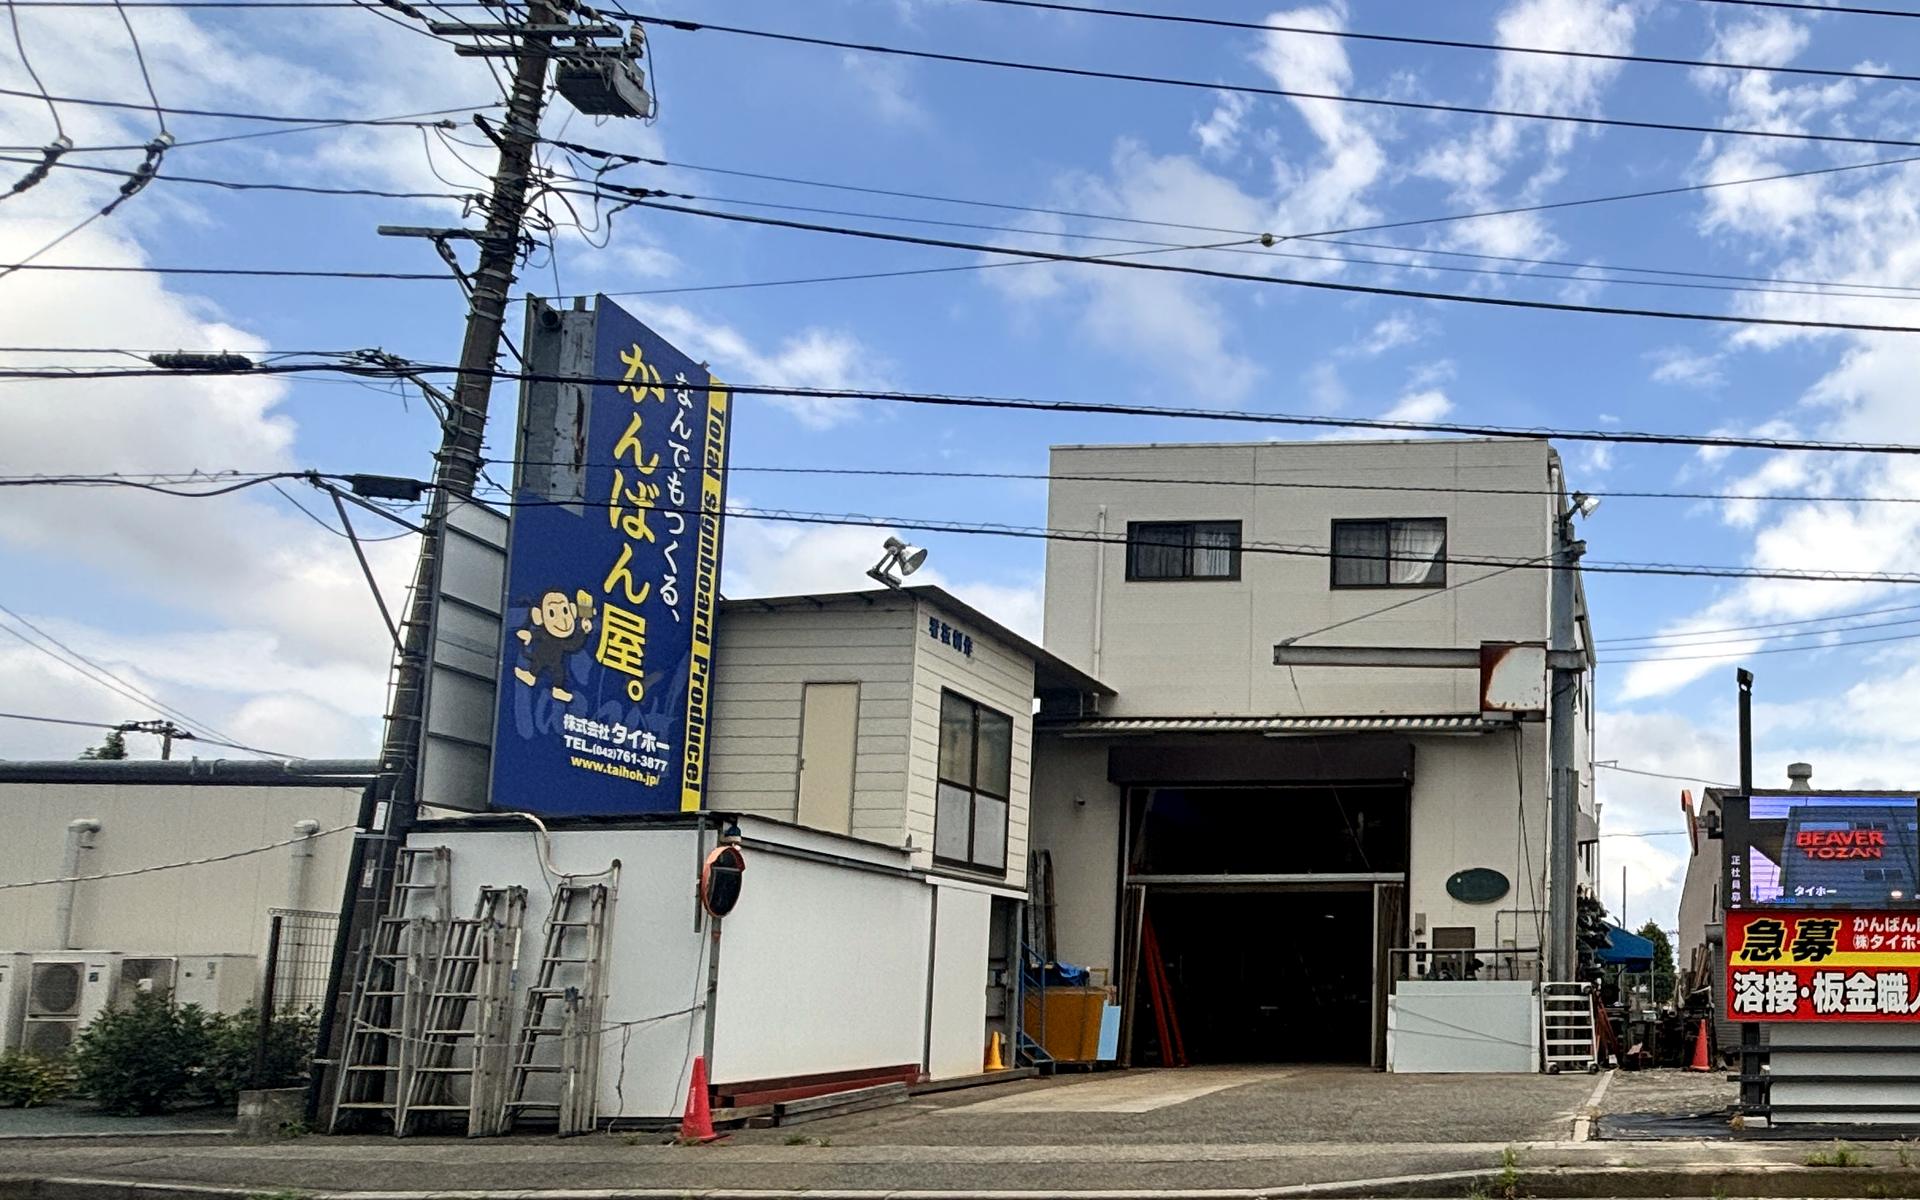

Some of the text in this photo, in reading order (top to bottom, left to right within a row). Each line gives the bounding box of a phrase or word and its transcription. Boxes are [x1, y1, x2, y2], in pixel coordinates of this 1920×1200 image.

[706, 407, 725, 482] Total
[596, 343, 666, 702] かんばん屋。
[660, 372, 694, 623] なんでもつくる、
[685, 654, 708, 792] Produce!
[1796, 830, 1886, 846] BEAVER
[1804, 847, 1882, 859] TOZAN
[1740, 918, 1842, 962] 急募
[1853, 916, 1920, 933] かんばん
